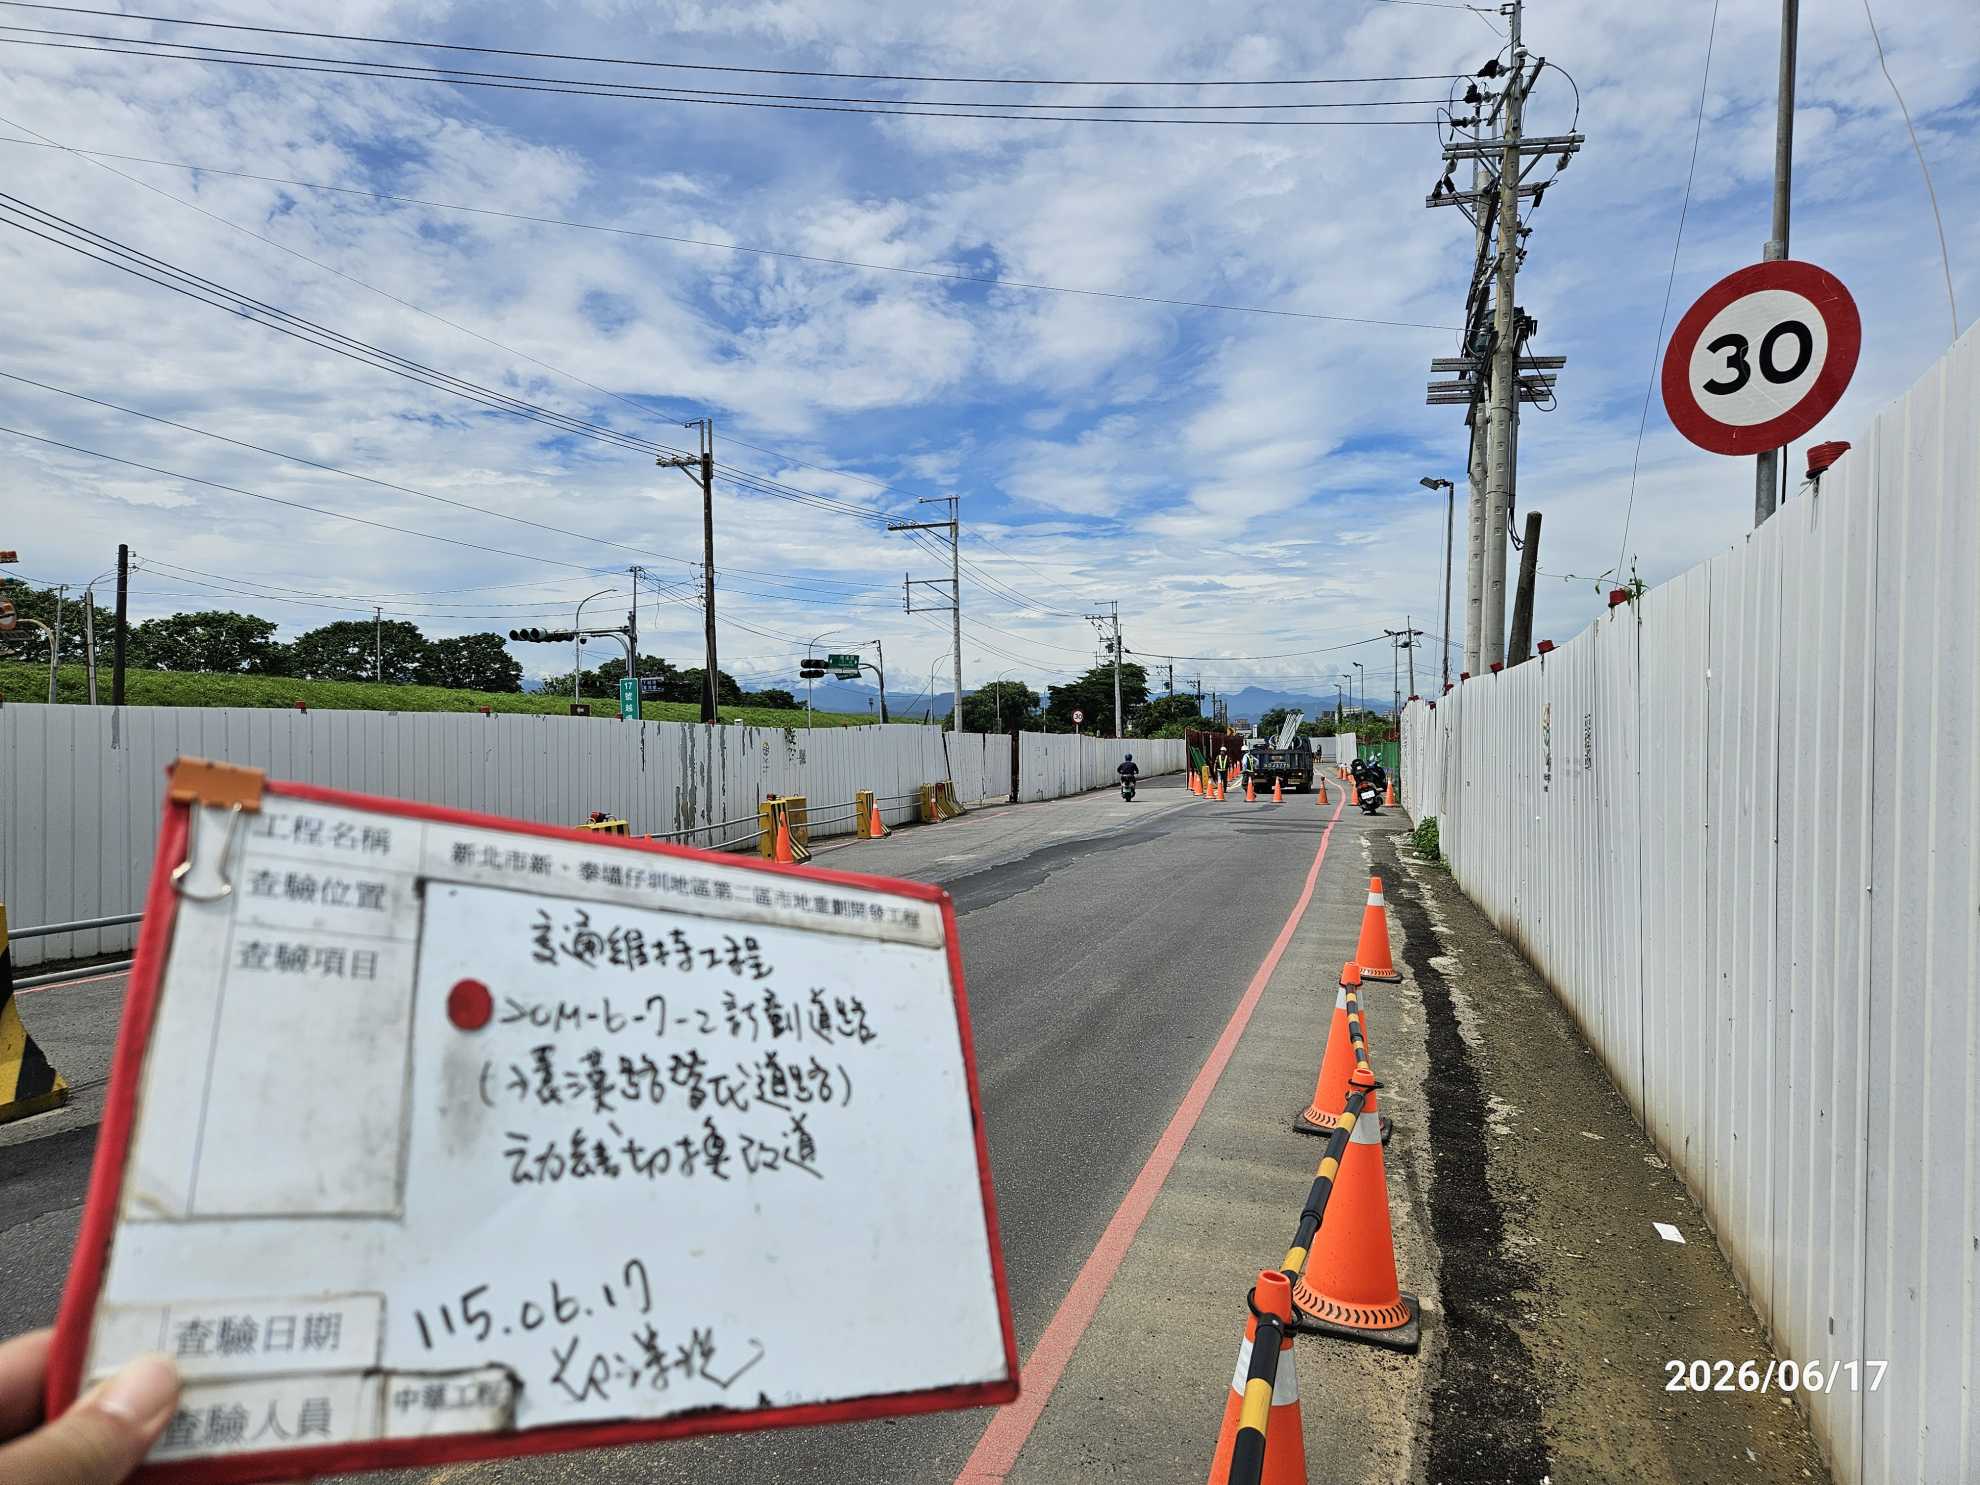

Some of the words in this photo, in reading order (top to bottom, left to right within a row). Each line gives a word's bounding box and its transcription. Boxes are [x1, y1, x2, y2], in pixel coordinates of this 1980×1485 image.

[1701, 319, 1813, 396] 30
[252, 814, 392, 855] 工程名稱
[248, 868, 387, 911] 查驗位置
[238, 940, 379, 980] 查驗項目
[531, 908, 775, 981] 交通維持工程
[412, 1257, 652, 1350] 115.06.17
[173, 1310, 343, 1358] 查驗日期
[394, 1380, 504, 1414] 中華工程
[161, 1394, 333, 1449] 查驗人員
